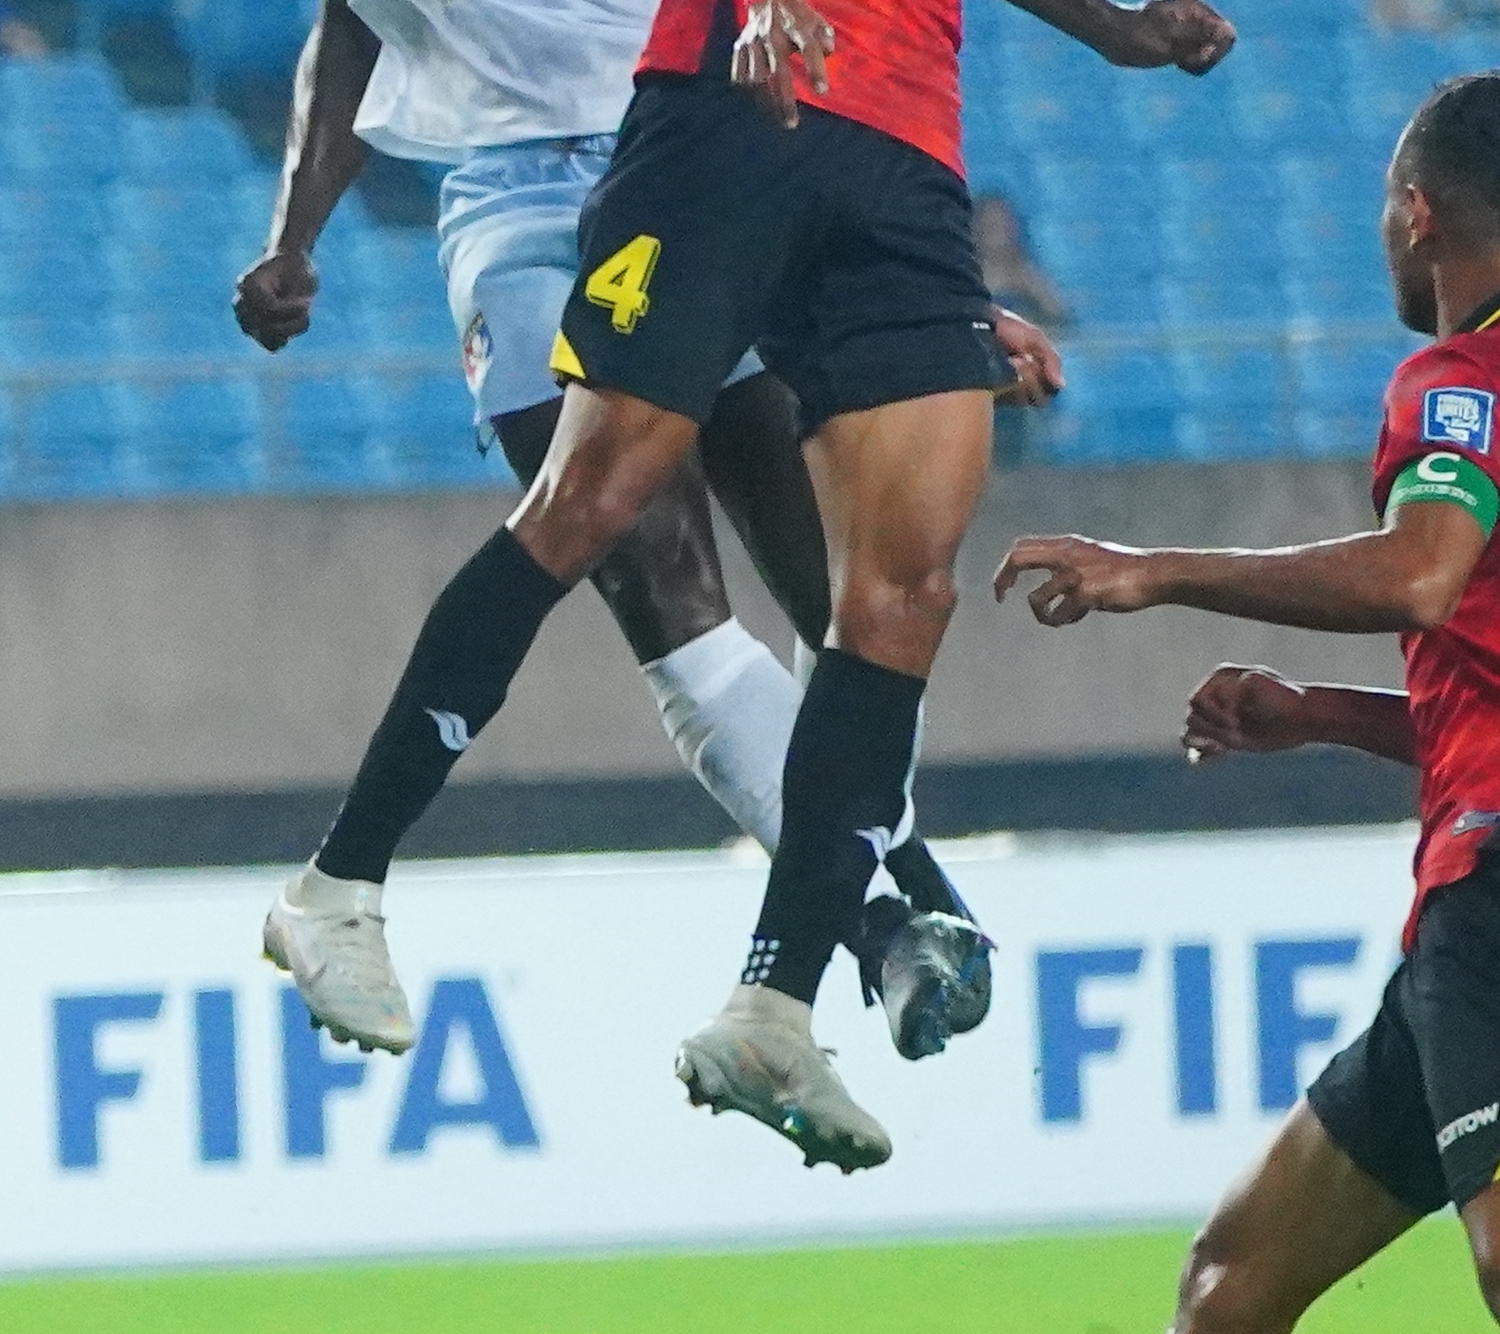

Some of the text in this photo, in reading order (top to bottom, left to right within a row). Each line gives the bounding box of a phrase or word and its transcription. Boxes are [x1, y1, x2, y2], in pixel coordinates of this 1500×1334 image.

[585, 234, 661, 334] 4
[1417, 451, 1461, 482] C
[51, 977, 542, 1170] FIFA
[1036, 937, 1363, 1122] FIF
